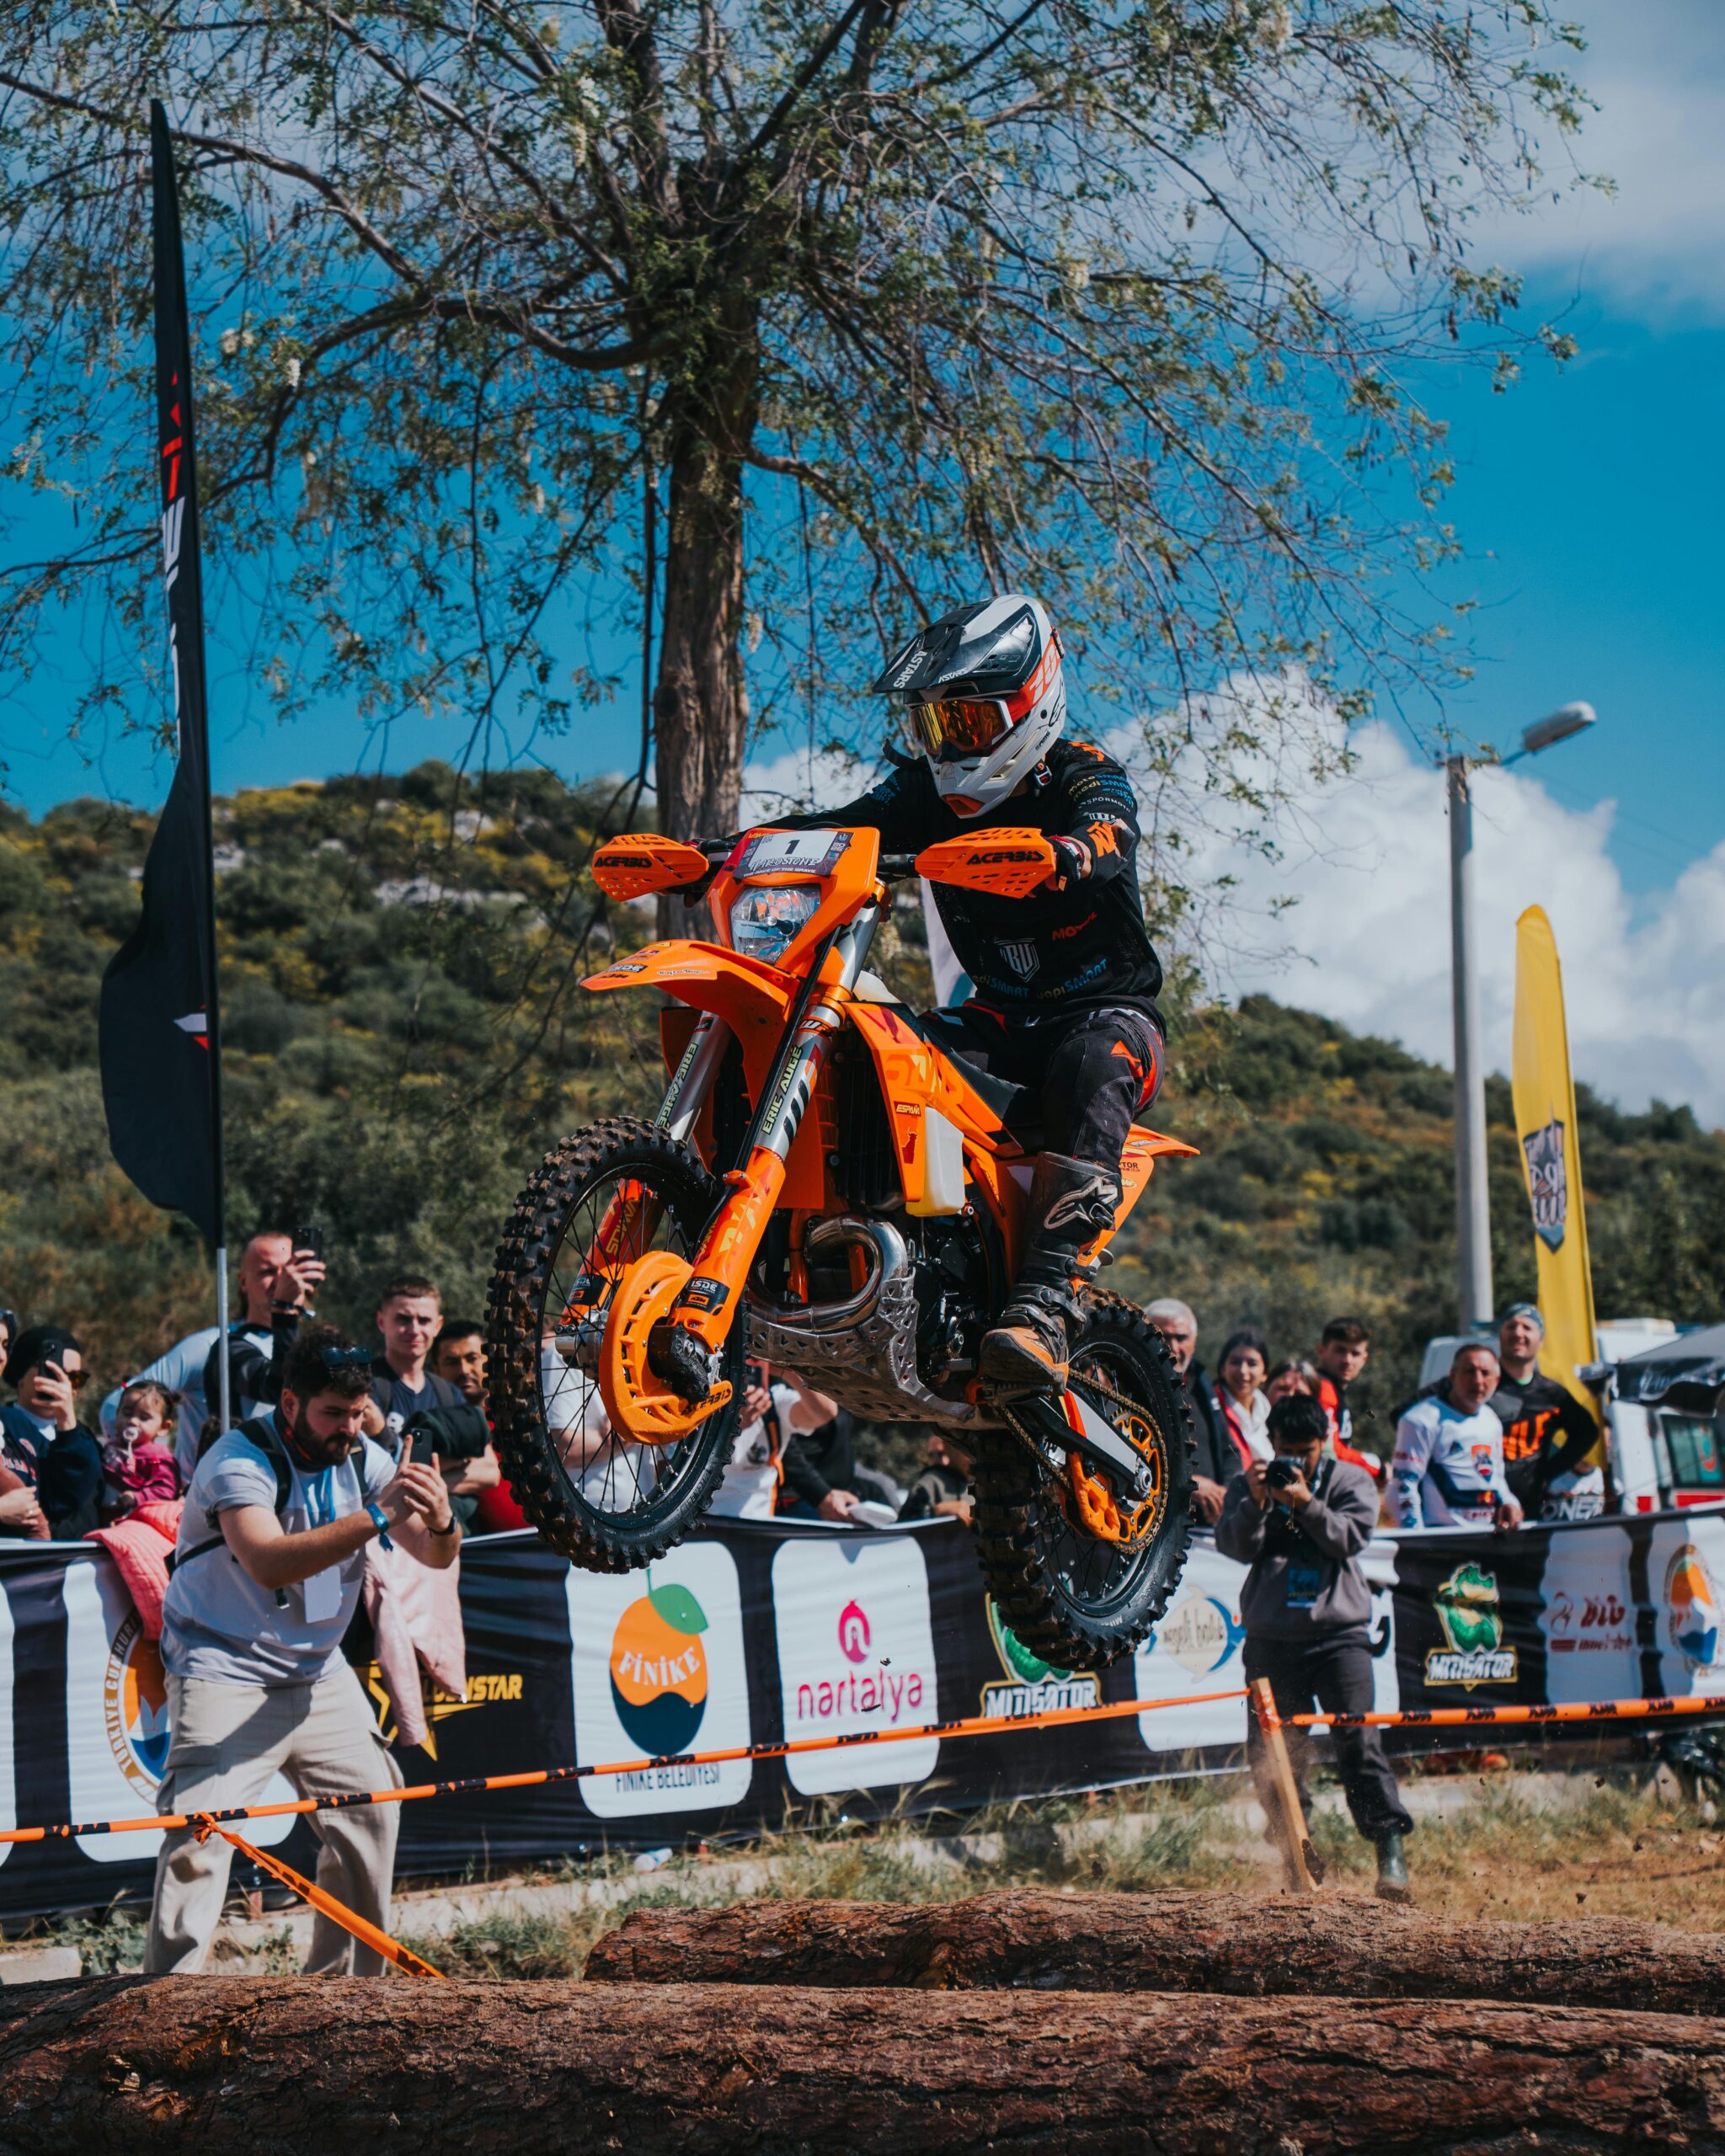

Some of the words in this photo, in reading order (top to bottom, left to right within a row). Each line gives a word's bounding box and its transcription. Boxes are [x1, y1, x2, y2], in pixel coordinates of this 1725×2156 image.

[894, 650, 927, 689] ASTARS
[785, 840, 800, 854] 1
[595, 857, 653, 868] ACERBIS
[966, 851, 1045, 865] ACERBIS
[762, 1095, 784, 1134] ERIC
[780, 1044, 803, 1096] AUGÉ
[896, 1104, 921, 1115] ESPAÑA
[798, 1667, 922, 1723] nartalya
